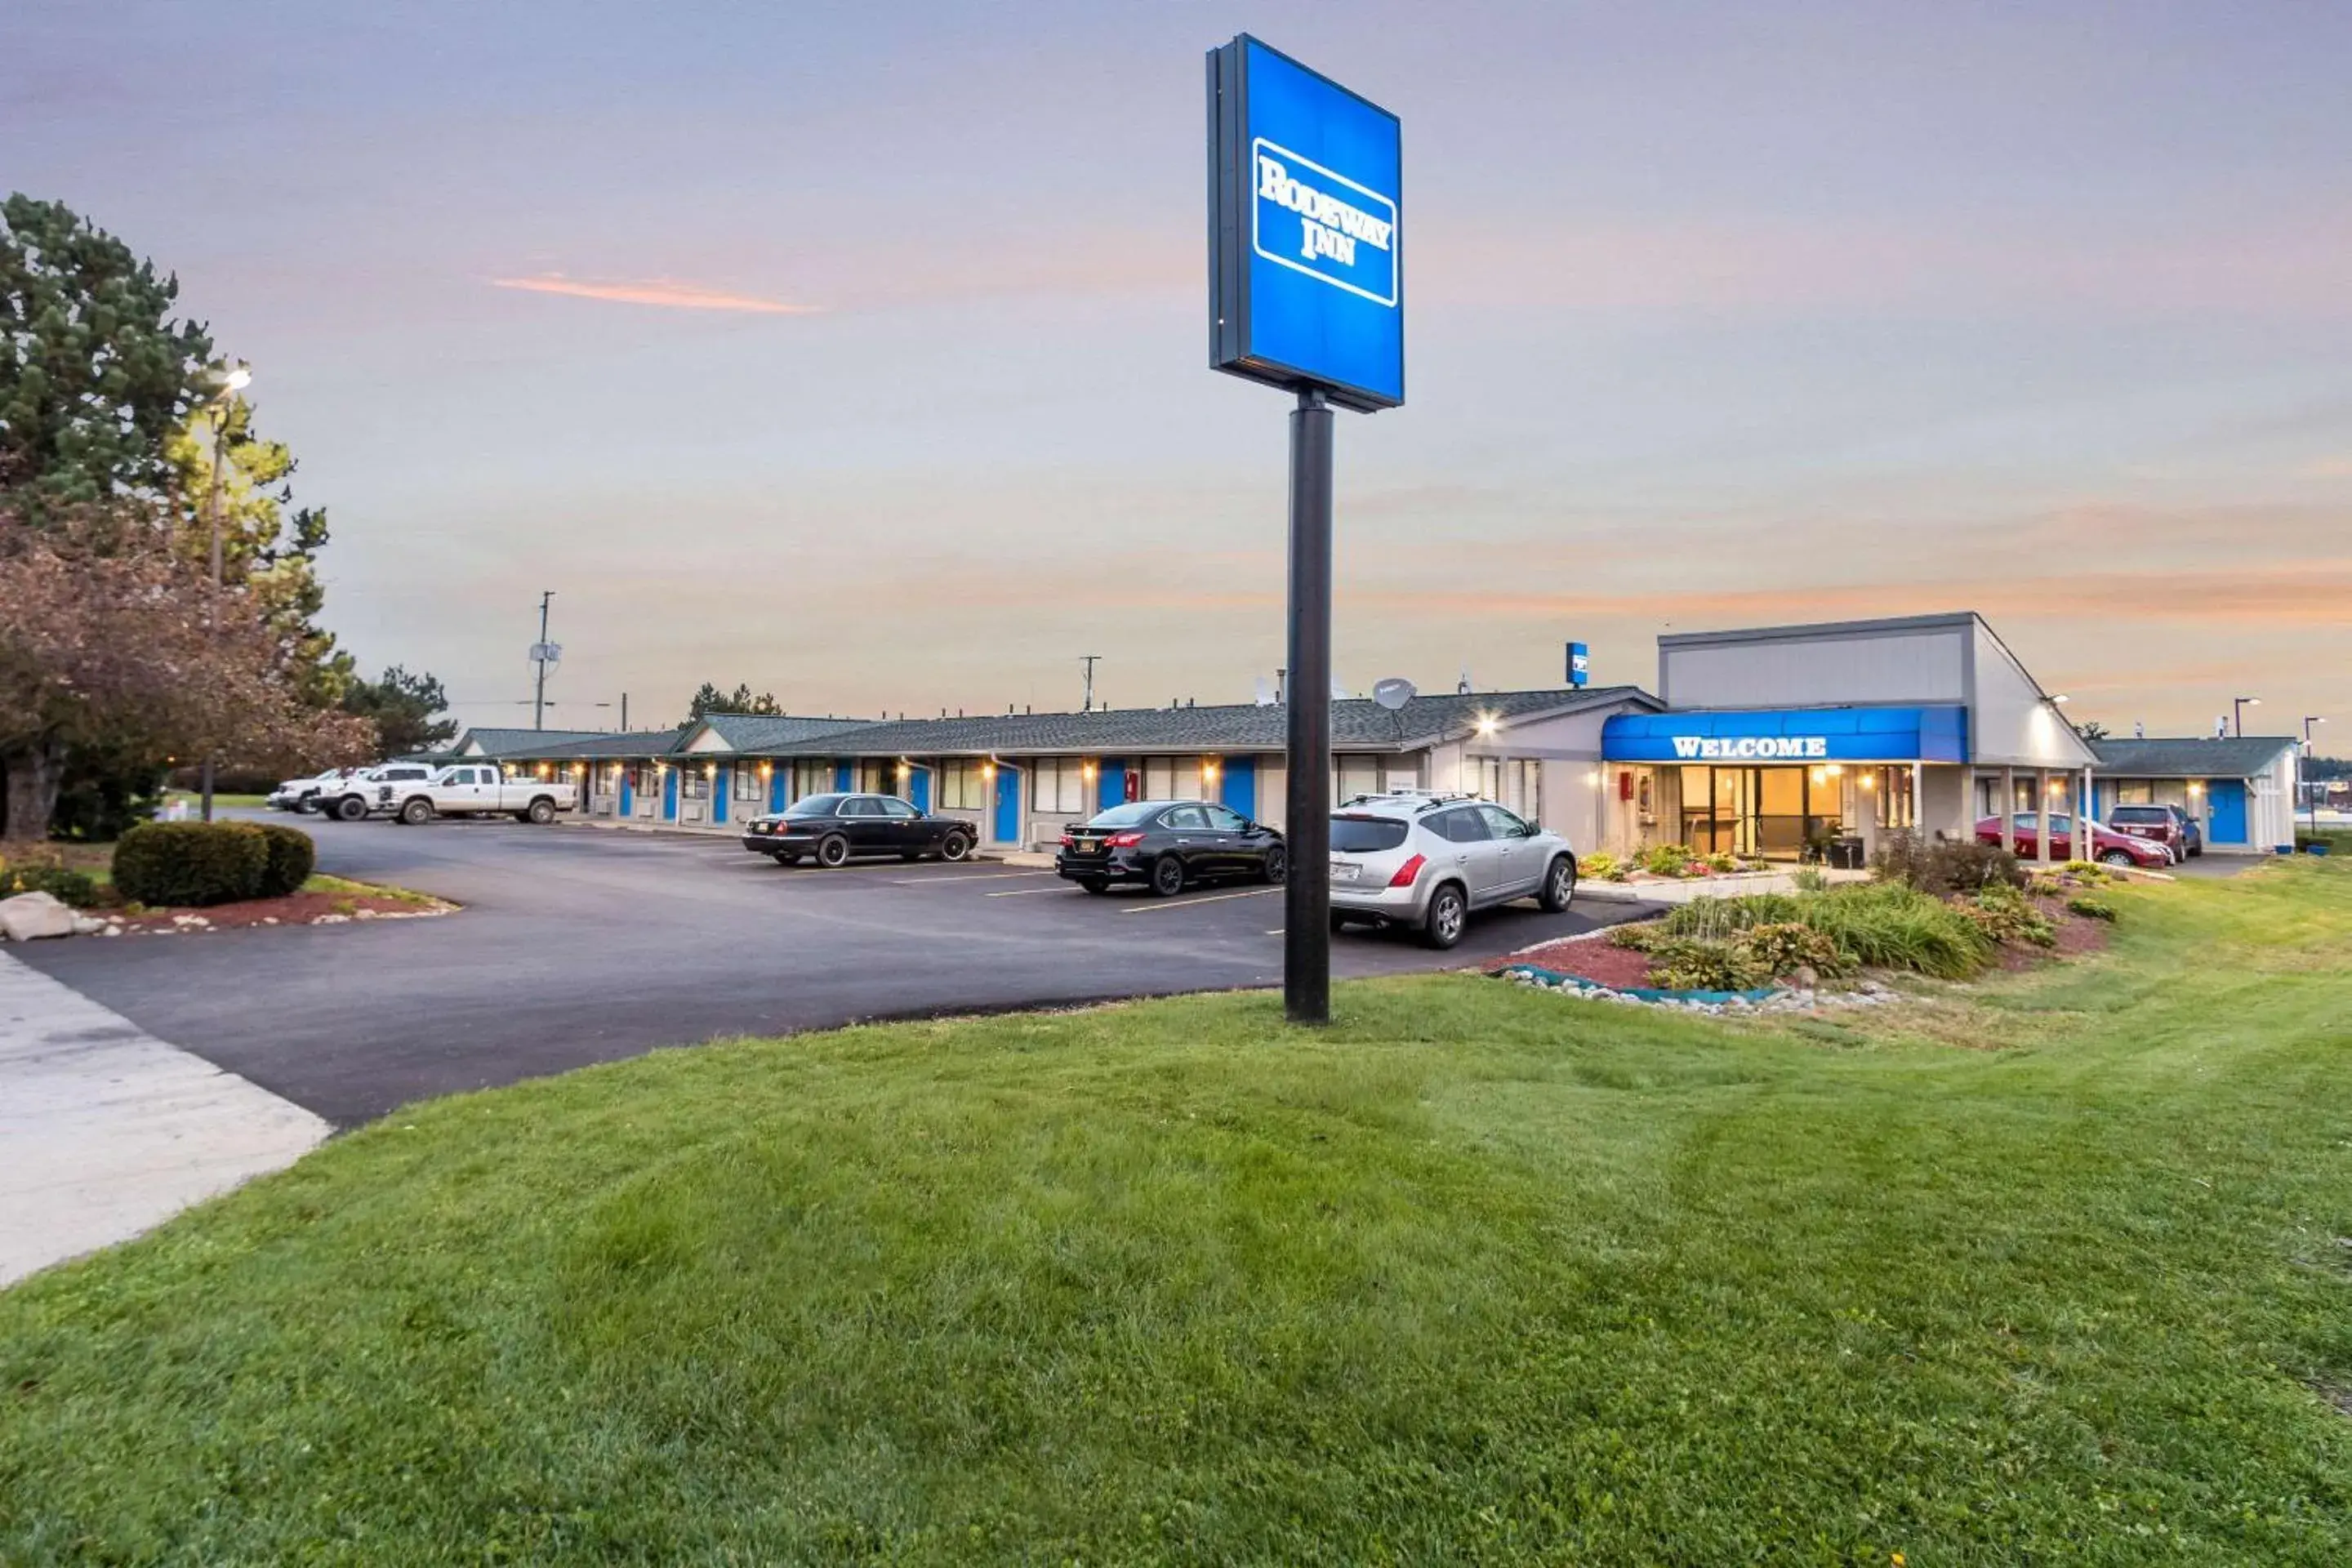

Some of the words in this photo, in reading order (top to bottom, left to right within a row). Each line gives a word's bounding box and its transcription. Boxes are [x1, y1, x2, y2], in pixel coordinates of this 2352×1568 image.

[1258, 154, 1392, 251] RODEWAY
[1301, 217, 1356, 266] INN
[1673, 736, 1827, 758] WELCOME
